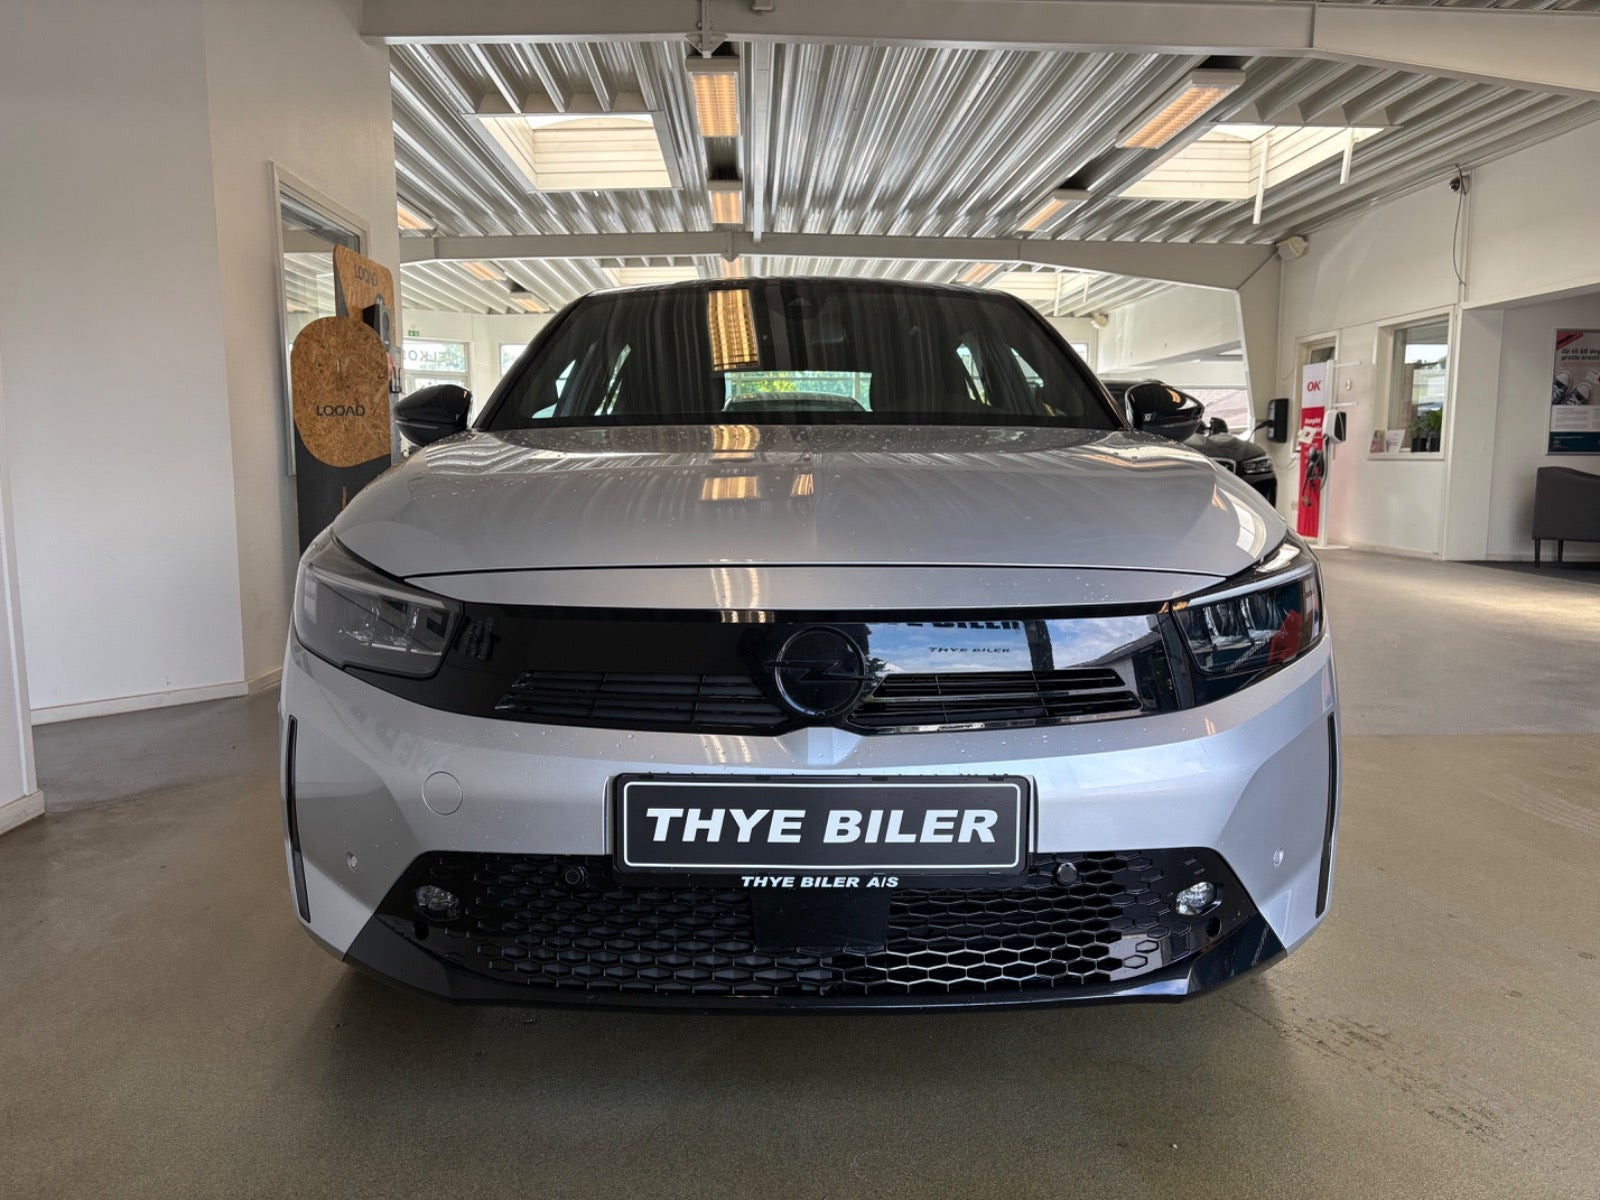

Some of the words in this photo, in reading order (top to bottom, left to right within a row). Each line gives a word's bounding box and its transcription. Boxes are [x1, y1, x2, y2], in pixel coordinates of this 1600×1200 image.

[1307, 381, 1321, 392] OK
[646, 808, 806, 843] THYE
[823, 809, 998, 844] BILER
[741, 876, 795, 888] THYE
[800, 876, 860, 888] BILER
[866, 876, 899, 888] A/S
